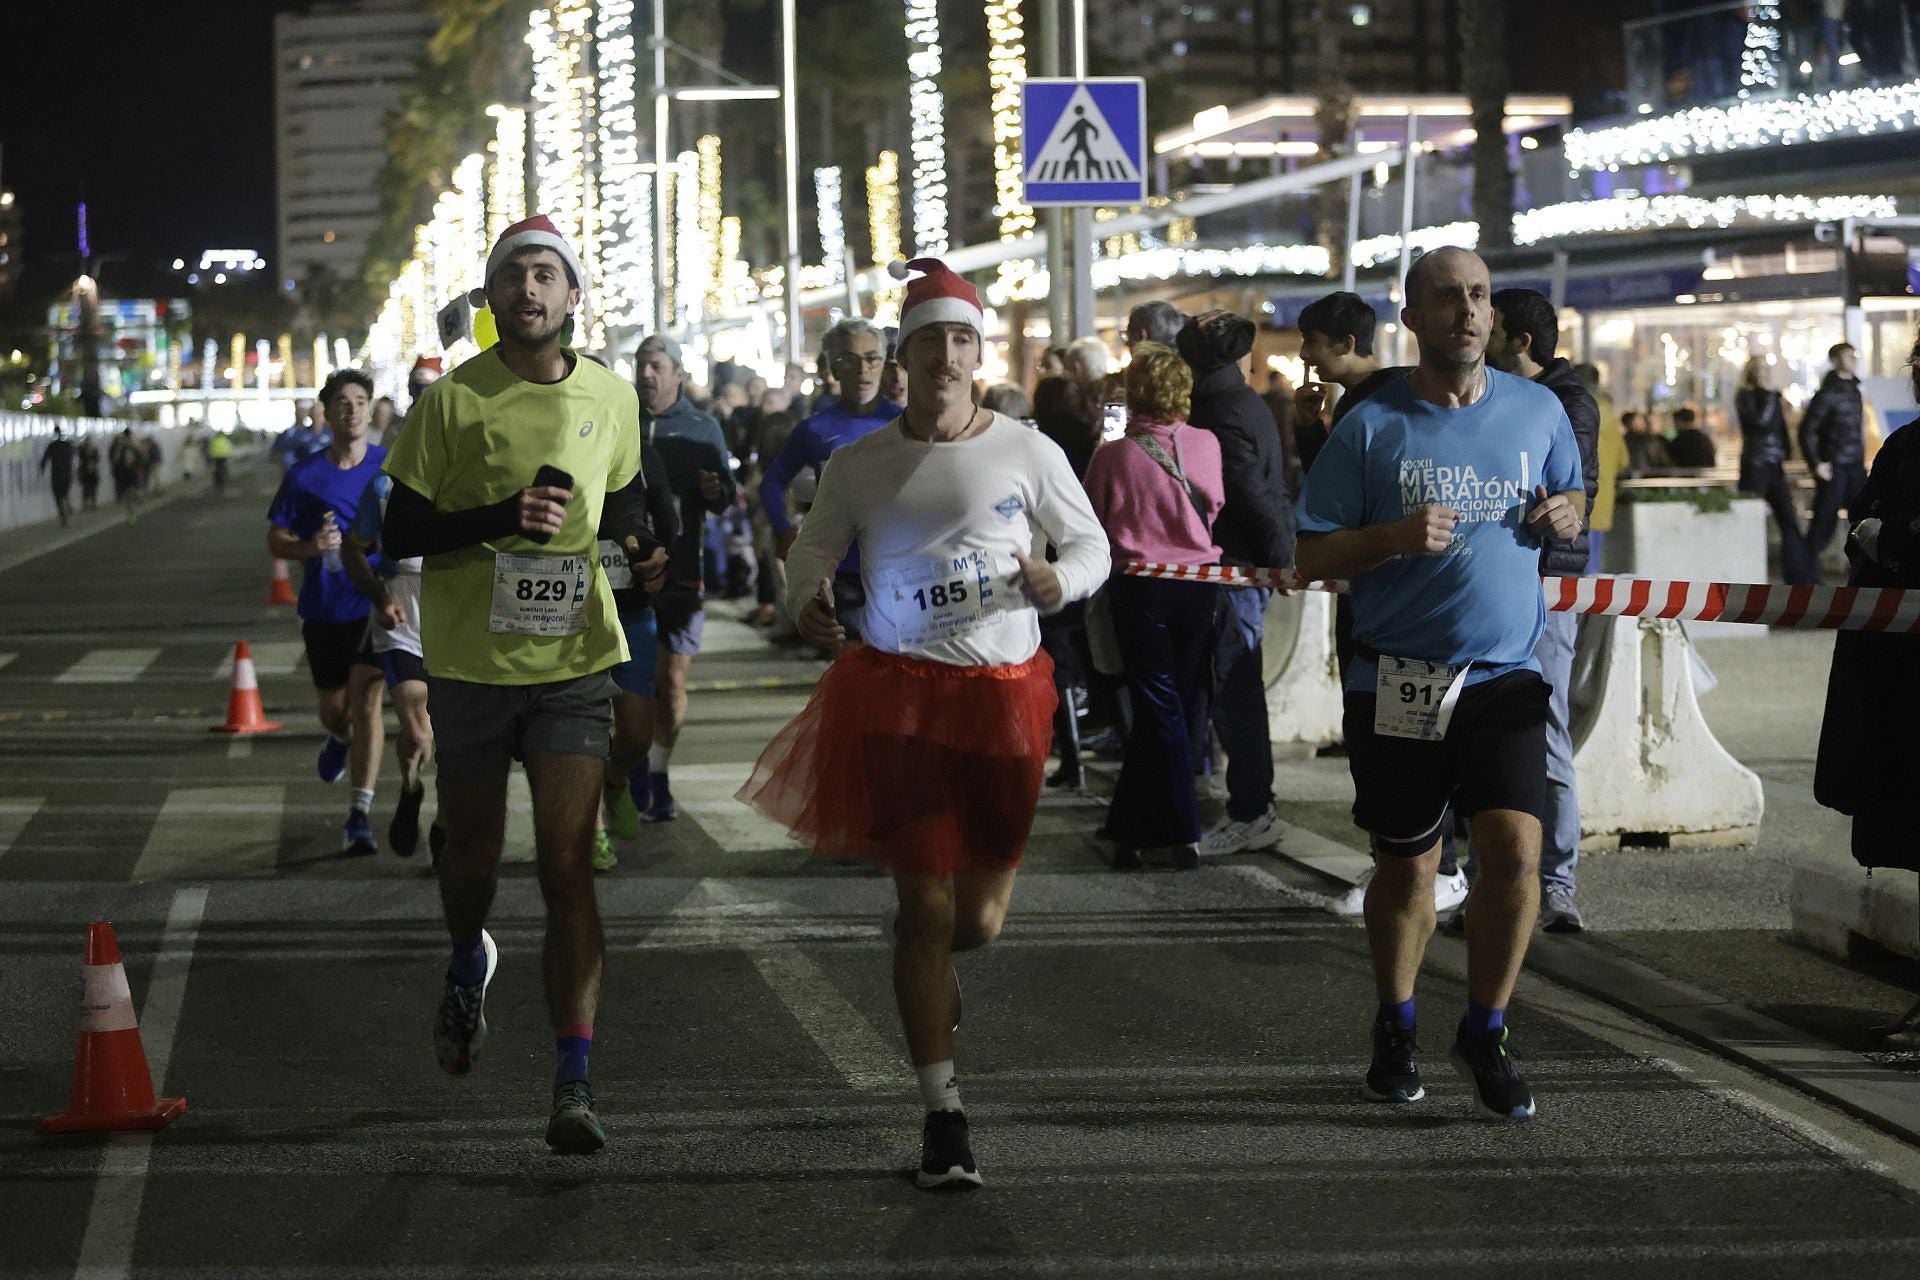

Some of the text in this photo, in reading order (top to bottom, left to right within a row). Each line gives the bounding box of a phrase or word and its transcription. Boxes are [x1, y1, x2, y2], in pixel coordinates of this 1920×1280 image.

[1400, 459, 1432, 470] XXXII
[1399, 465, 1479, 488] MEDIA
[1401, 476, 1519, 505] MARATÓN
[561, 559, 574, 572] M
[953, 557, 969, 571] M
[516, 578, 567, 601] 829
[913, 580, 968, 611] 185
[532, 614, 566, 623] mayoral
